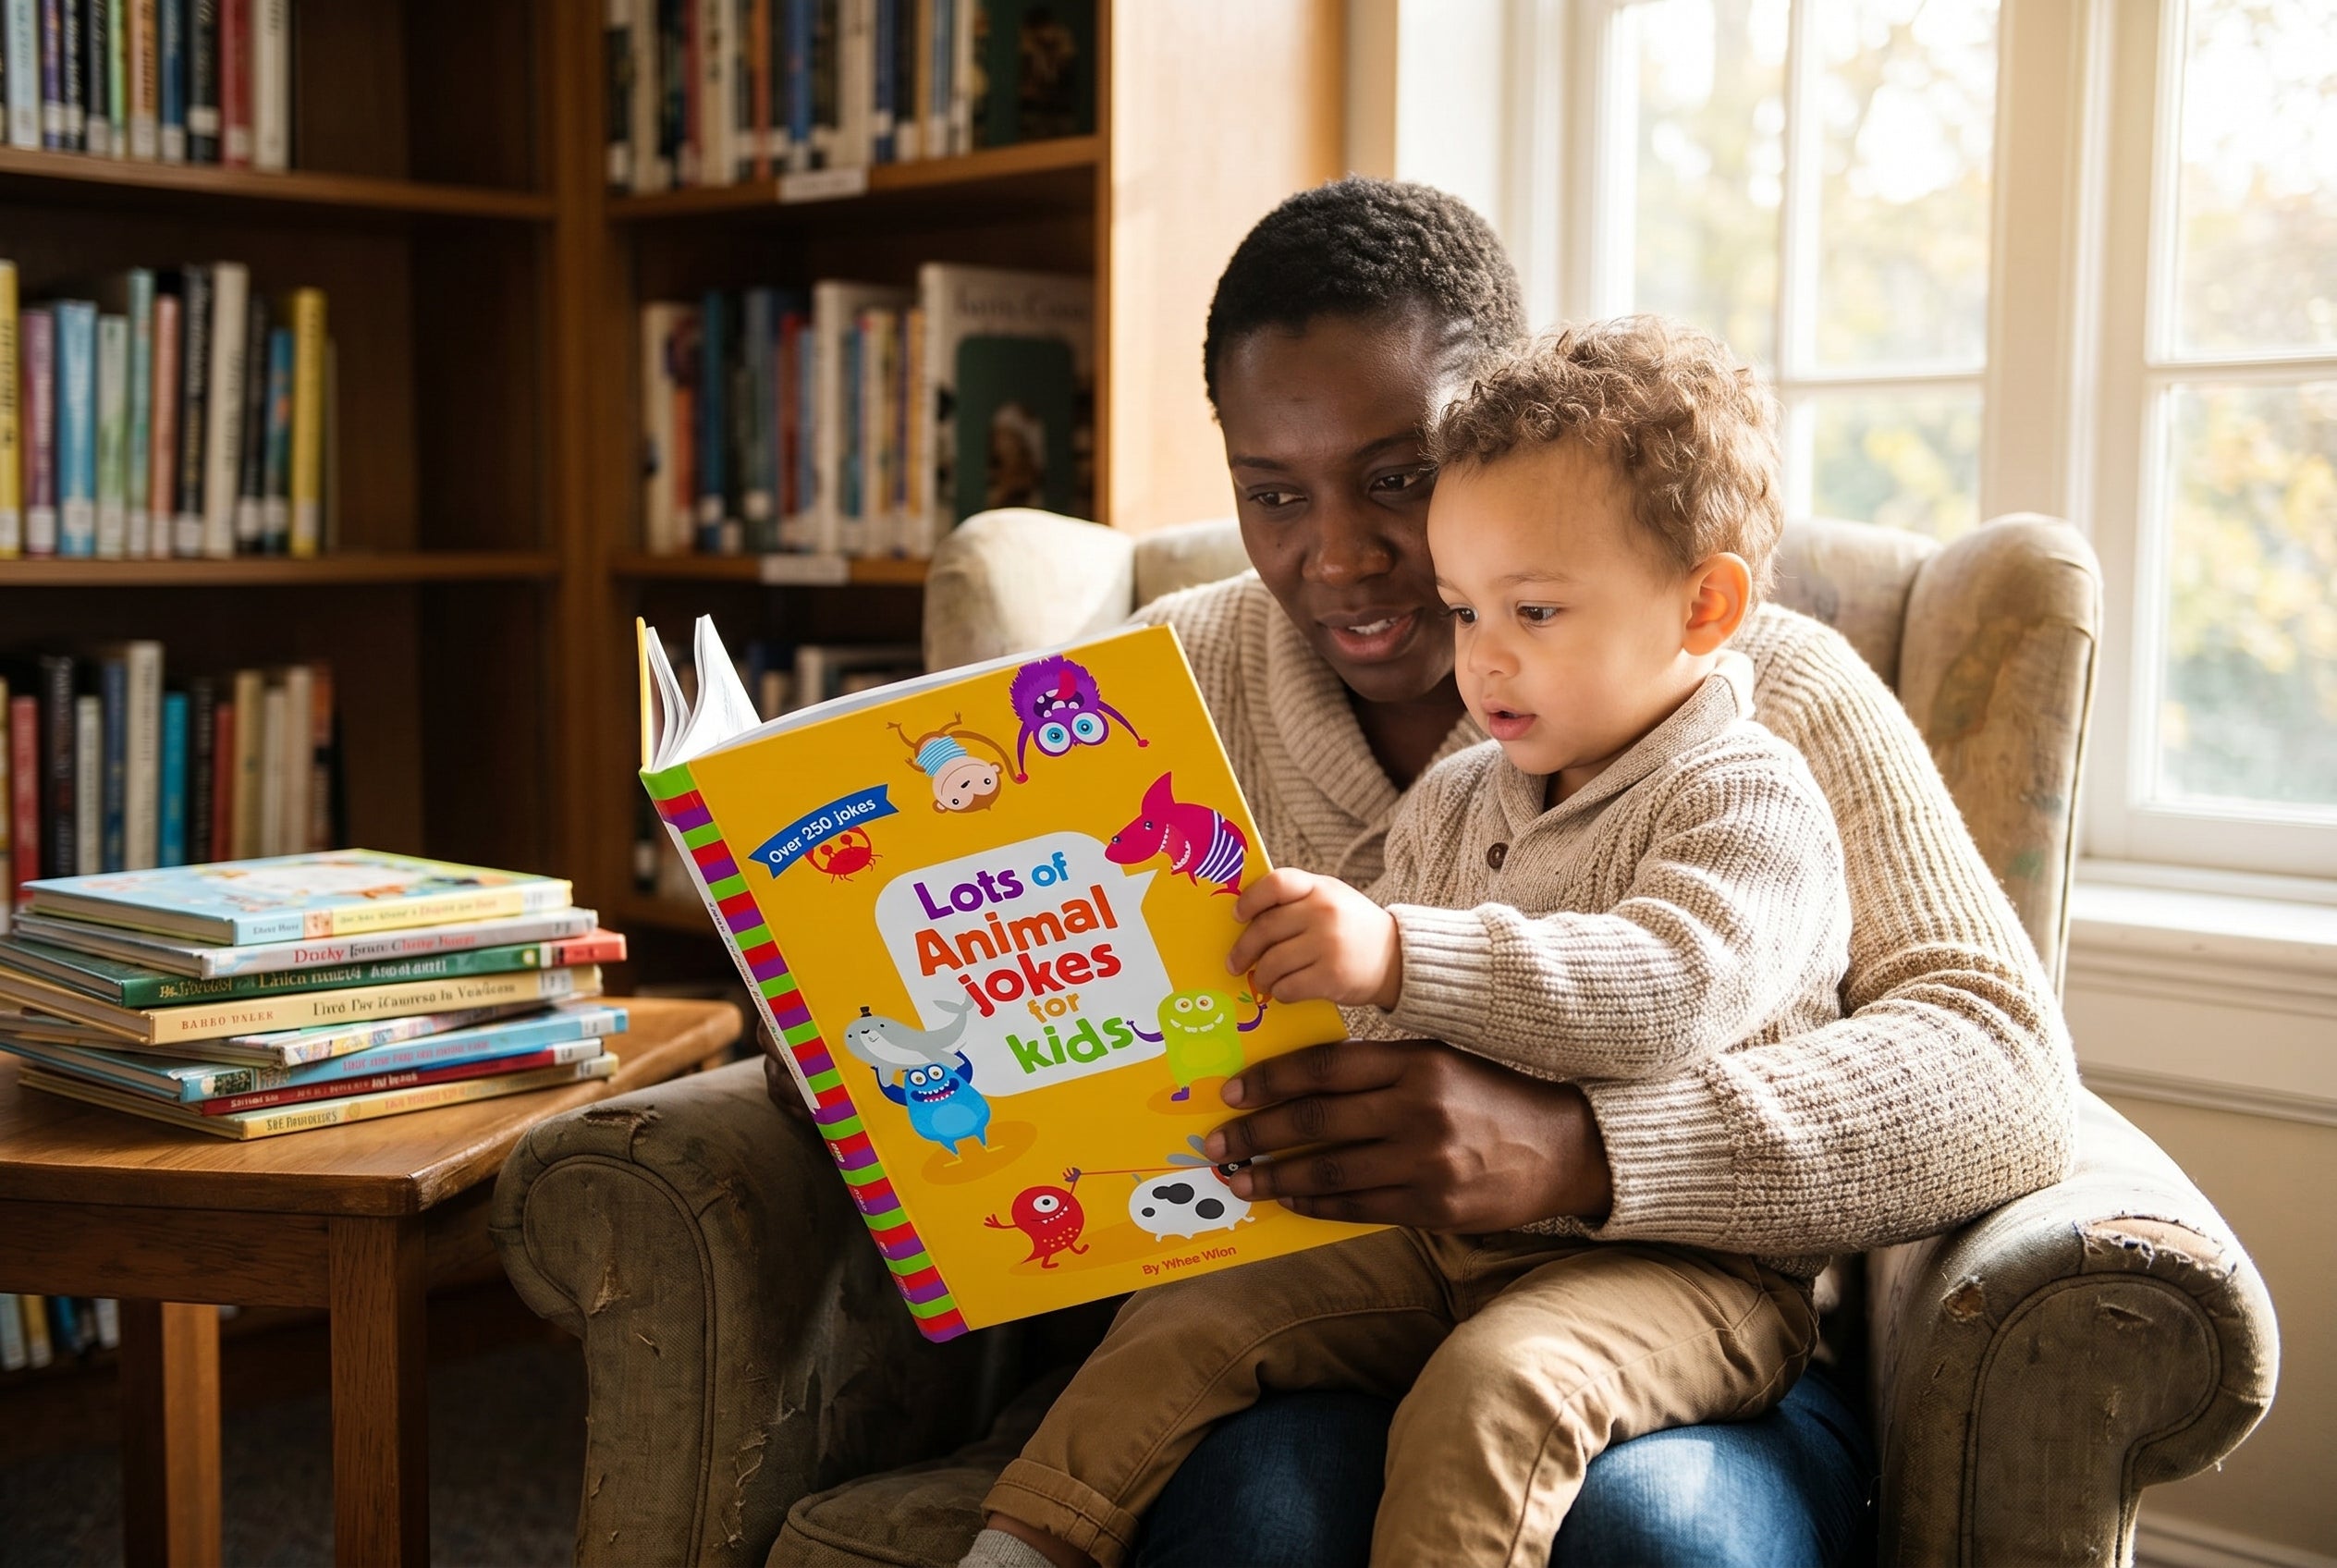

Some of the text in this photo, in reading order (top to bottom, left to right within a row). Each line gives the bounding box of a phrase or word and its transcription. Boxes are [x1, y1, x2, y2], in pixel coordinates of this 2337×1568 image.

[769, 799, 876, 863] Over 250 jokes
[913, 851, 1070, 921] Lots of
[914, 884, 1119, 976] Animal
[958, 943, 1122, 1018] jokes
[1027, 992, 1081, 1023] for
[1005, 1017, 1134, 1074] kids
[1142, 1264, 1159, 1275] By
[1161, 1255, 1201, 1270] Whee
